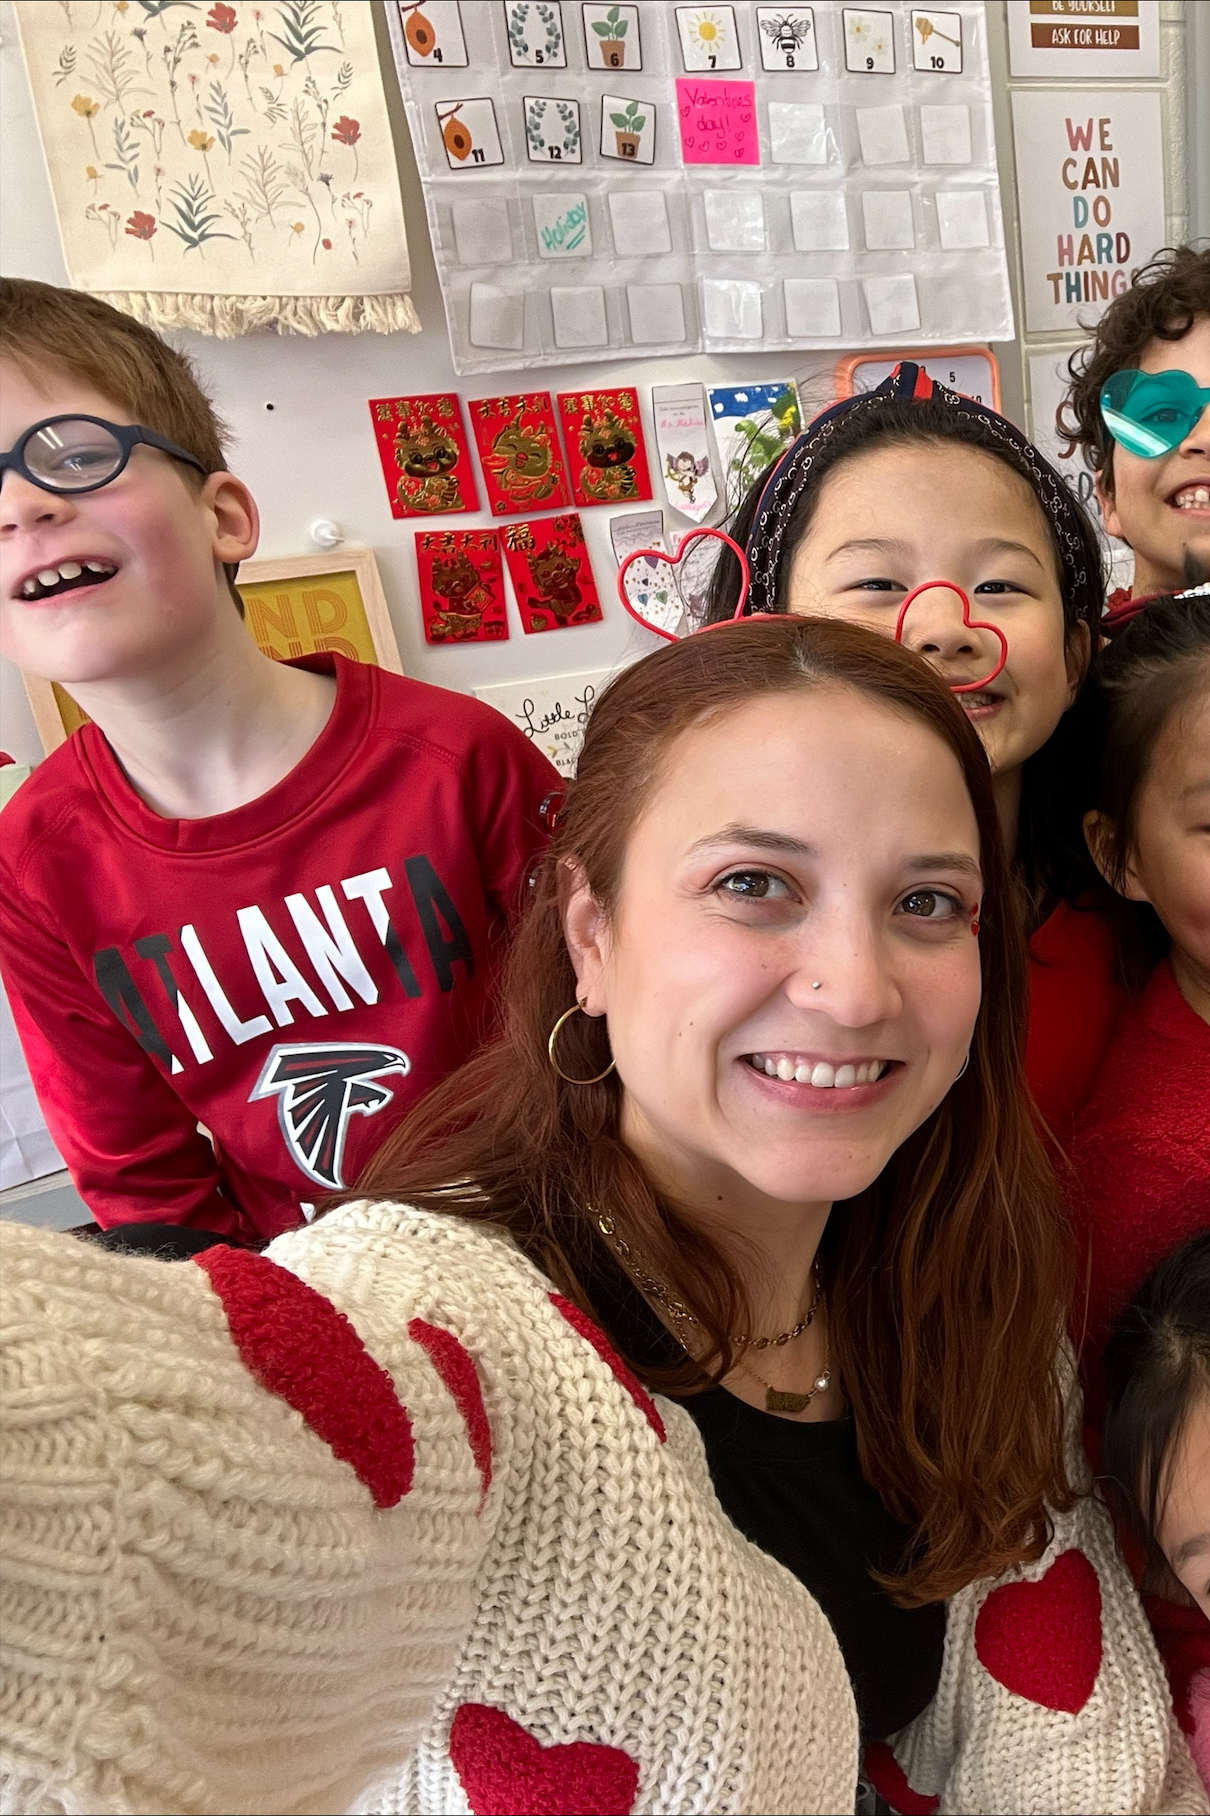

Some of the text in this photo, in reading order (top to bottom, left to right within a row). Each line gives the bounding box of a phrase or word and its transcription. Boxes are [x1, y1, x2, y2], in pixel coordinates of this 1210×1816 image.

[1052, 28, 1121, 45] ASK FOR HELP
[433, 48, 443, 63] 4
[535, 49, 544, 64] 5
[610, 52, 619, 66] 6
[708, 55, 717, 68] 7
[786, 56, 795, 68] 8
[931, 57, 944, 69] 10
[866, 57, 874, 70] 9
[1065, 117, 1113, 152] WE
[472, 148, 485, 163] 11
[548, 145, 562, 160] 12
[622, 142, 635, 156] 13
[1062, 156, 1120, 190] CAN
[1073, 195, 1111, 229] DO
[1057, 232, 1131, 267] HARD
[949, 371, 956, 383] 5
[505, 523, 536, 553] 福
[515, 698, 575, 739] Little
[93, 853, 475, 1075] ATLANTA
